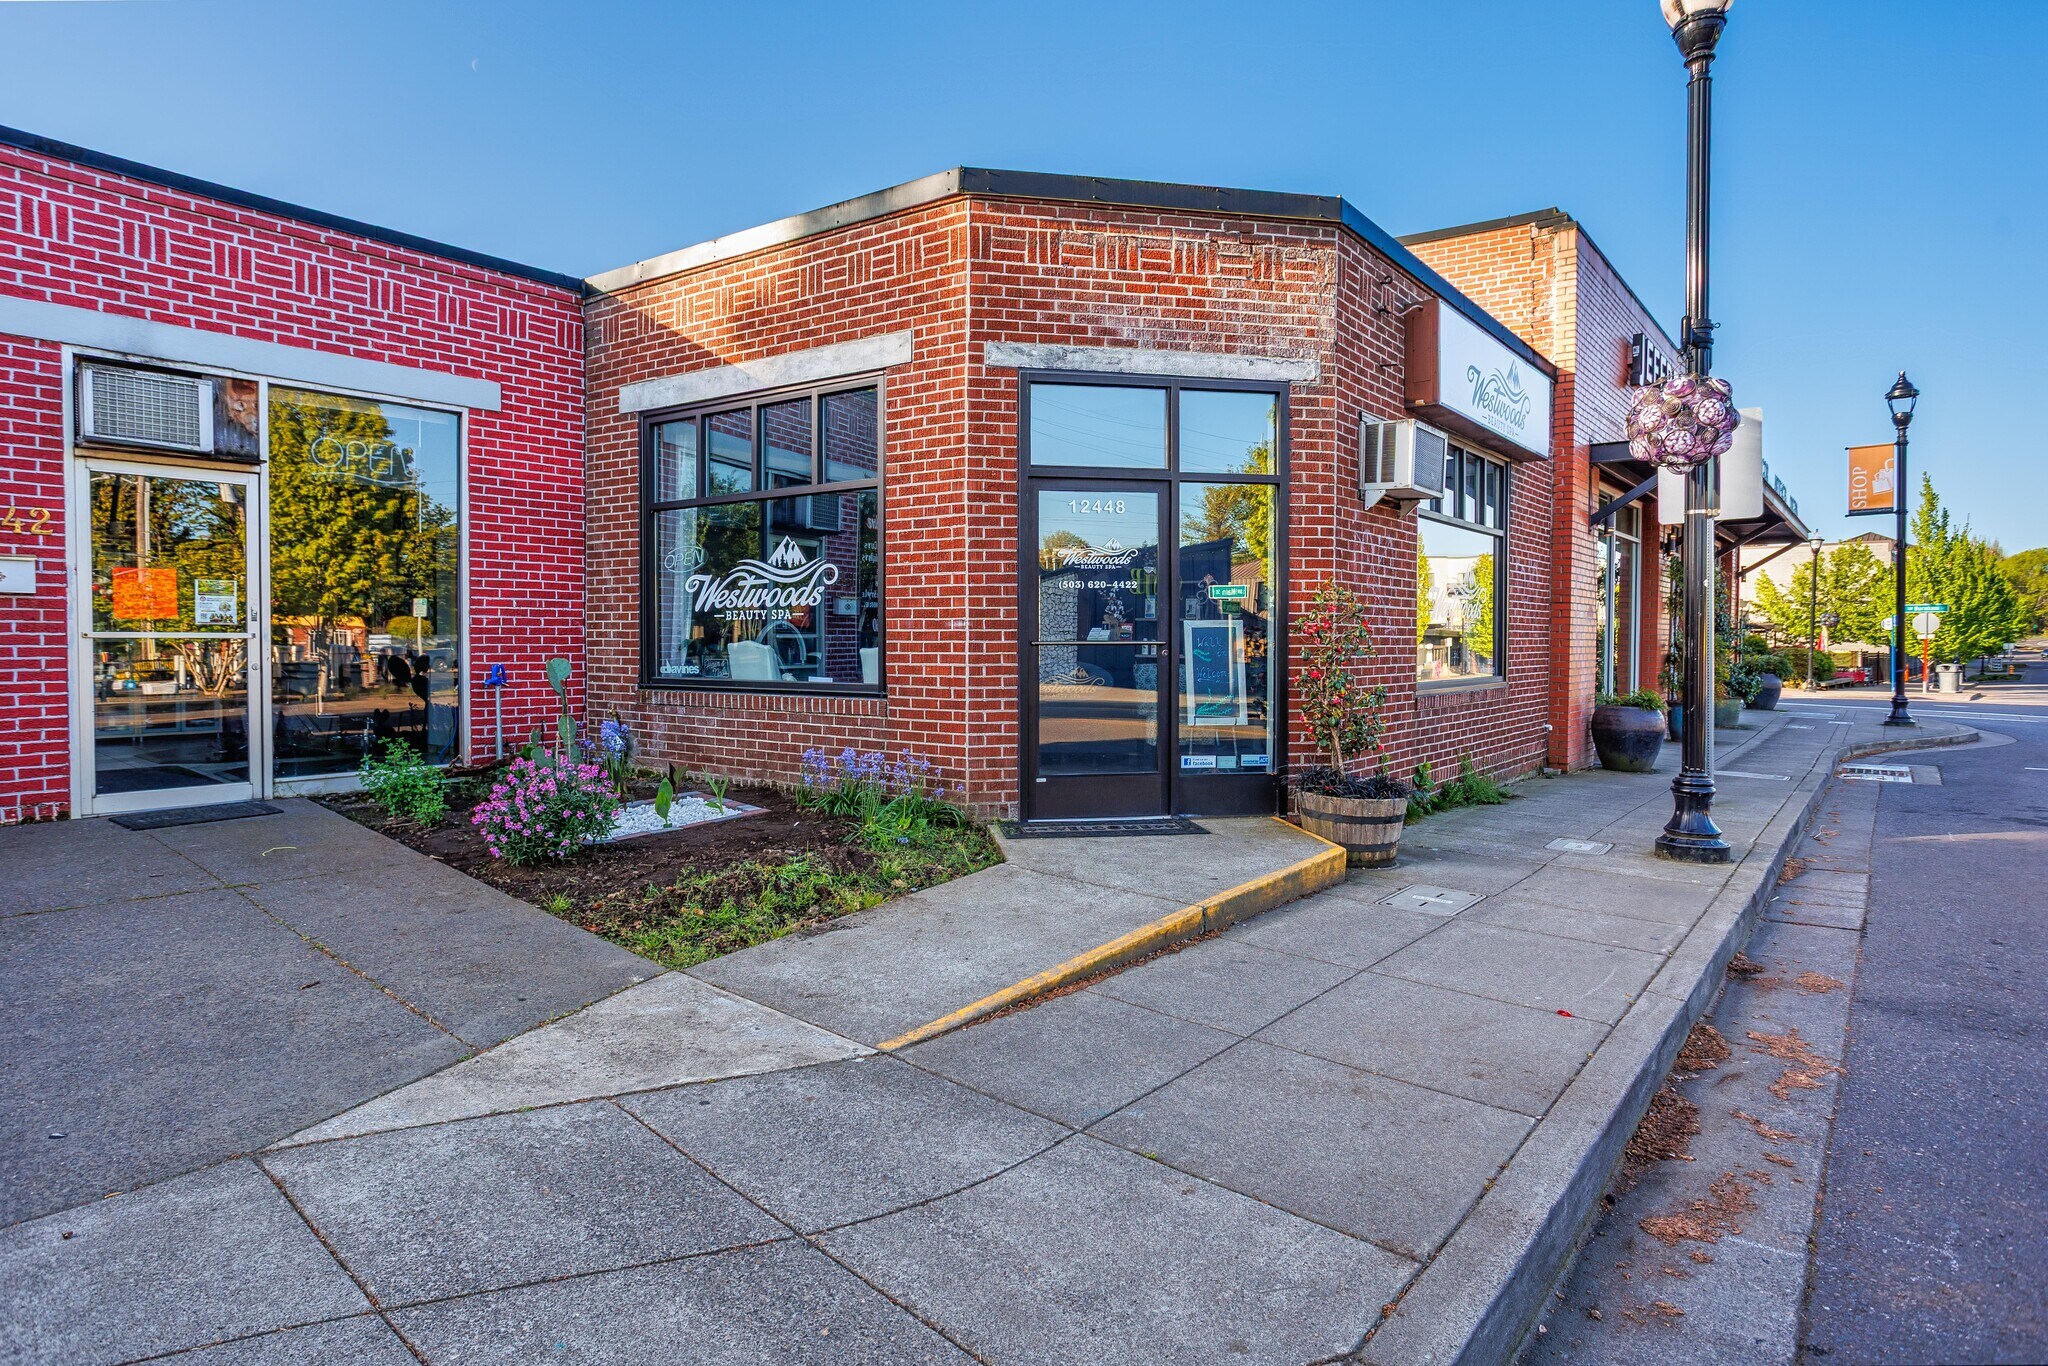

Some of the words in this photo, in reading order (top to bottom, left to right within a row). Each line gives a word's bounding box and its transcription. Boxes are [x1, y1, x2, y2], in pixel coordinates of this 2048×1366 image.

[1467, 365, 1531, 430] Westwoods
[1487, 414, 1506, 432] BEAUTY
[311, 436, 417, 477] OPEN
[1852, 467, 1867, 508] SHOP
[1068, 499, 1126, 514] 12448
[0, 505, 54, 535] 42
[664, 549, 704, 568] OPEN
[1057, 548, 1139, 566] Westwoods
[685, 563, 839, 612] Westwoods
[1058, 581, 1085, 589] (503)
[1087, 581, 1138, 589] 620-4422
[725, 610, 768, 621] BEAUTY
[771, 609, 792, 620] SPA
[660, 659, 700, 674] davines
